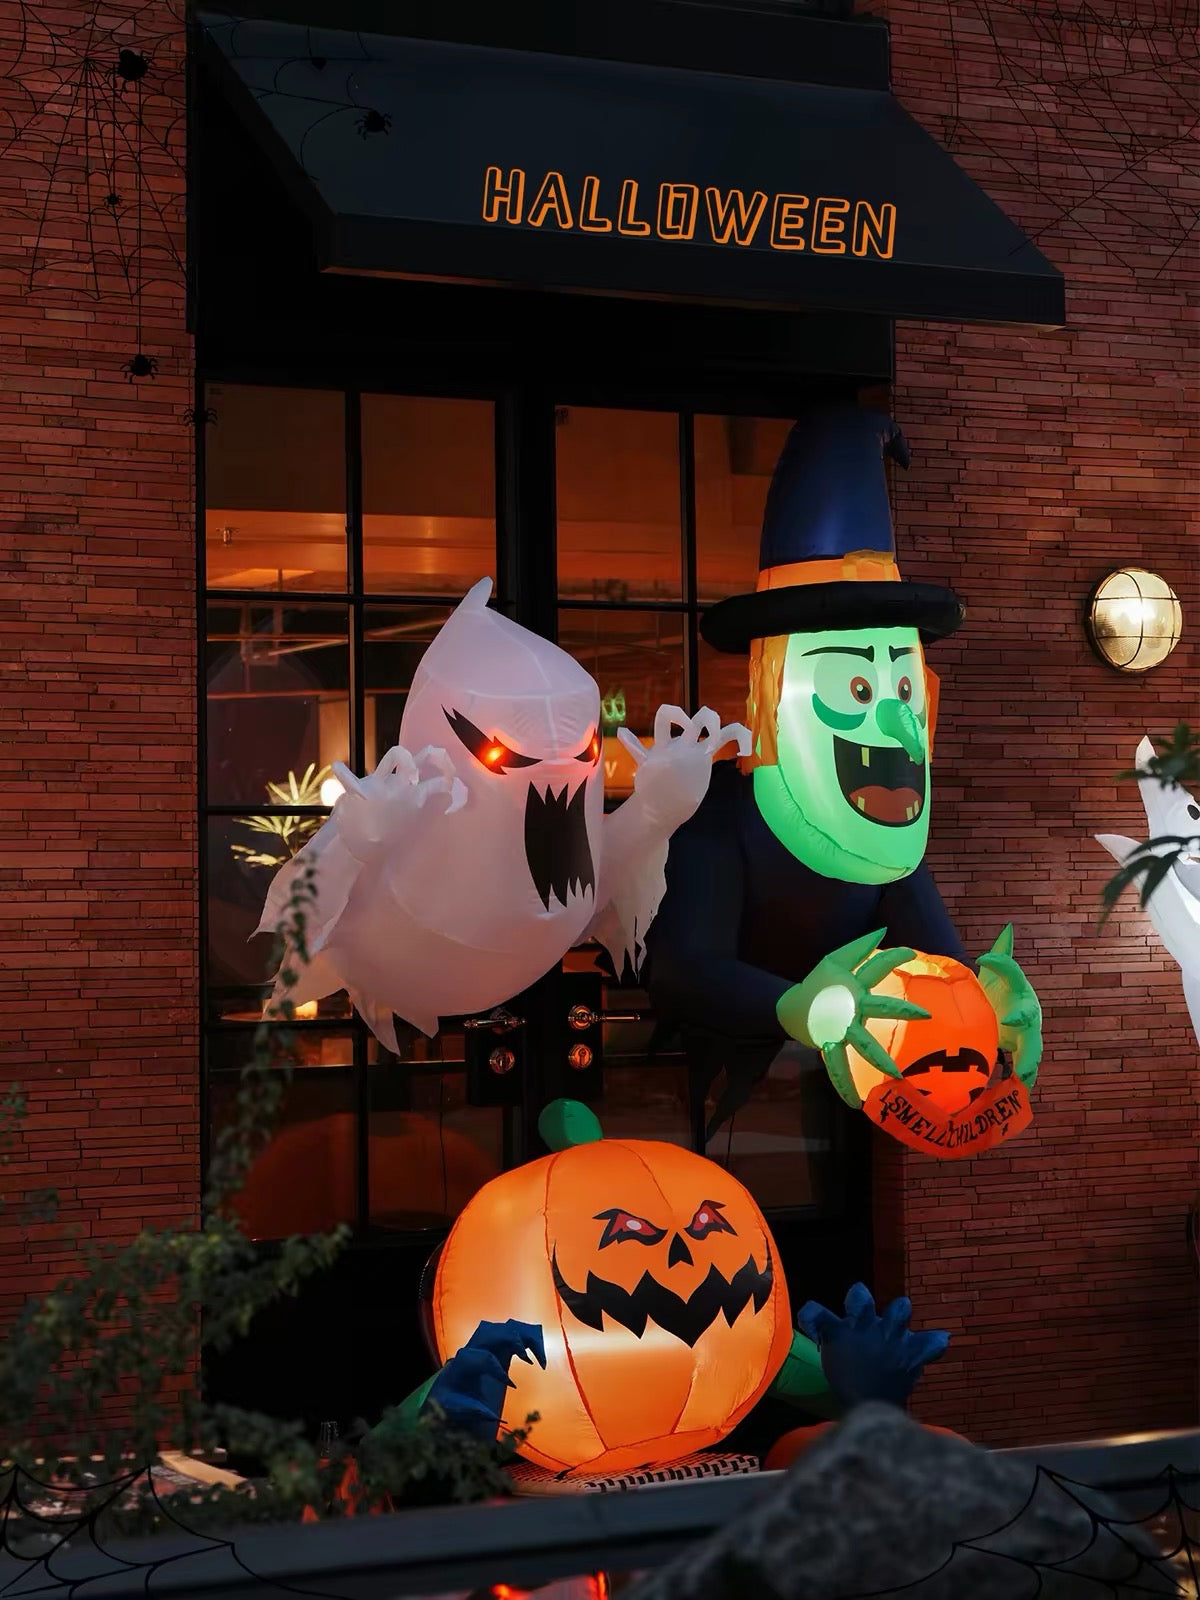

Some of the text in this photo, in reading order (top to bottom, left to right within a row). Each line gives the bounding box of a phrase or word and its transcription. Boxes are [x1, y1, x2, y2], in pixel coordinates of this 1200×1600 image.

[482, 166, 896, 259] HALLOWEEN
[887, 1095, 947, 1147] SMELL
[947, 1090, 1022, 1149] CHILDREN
